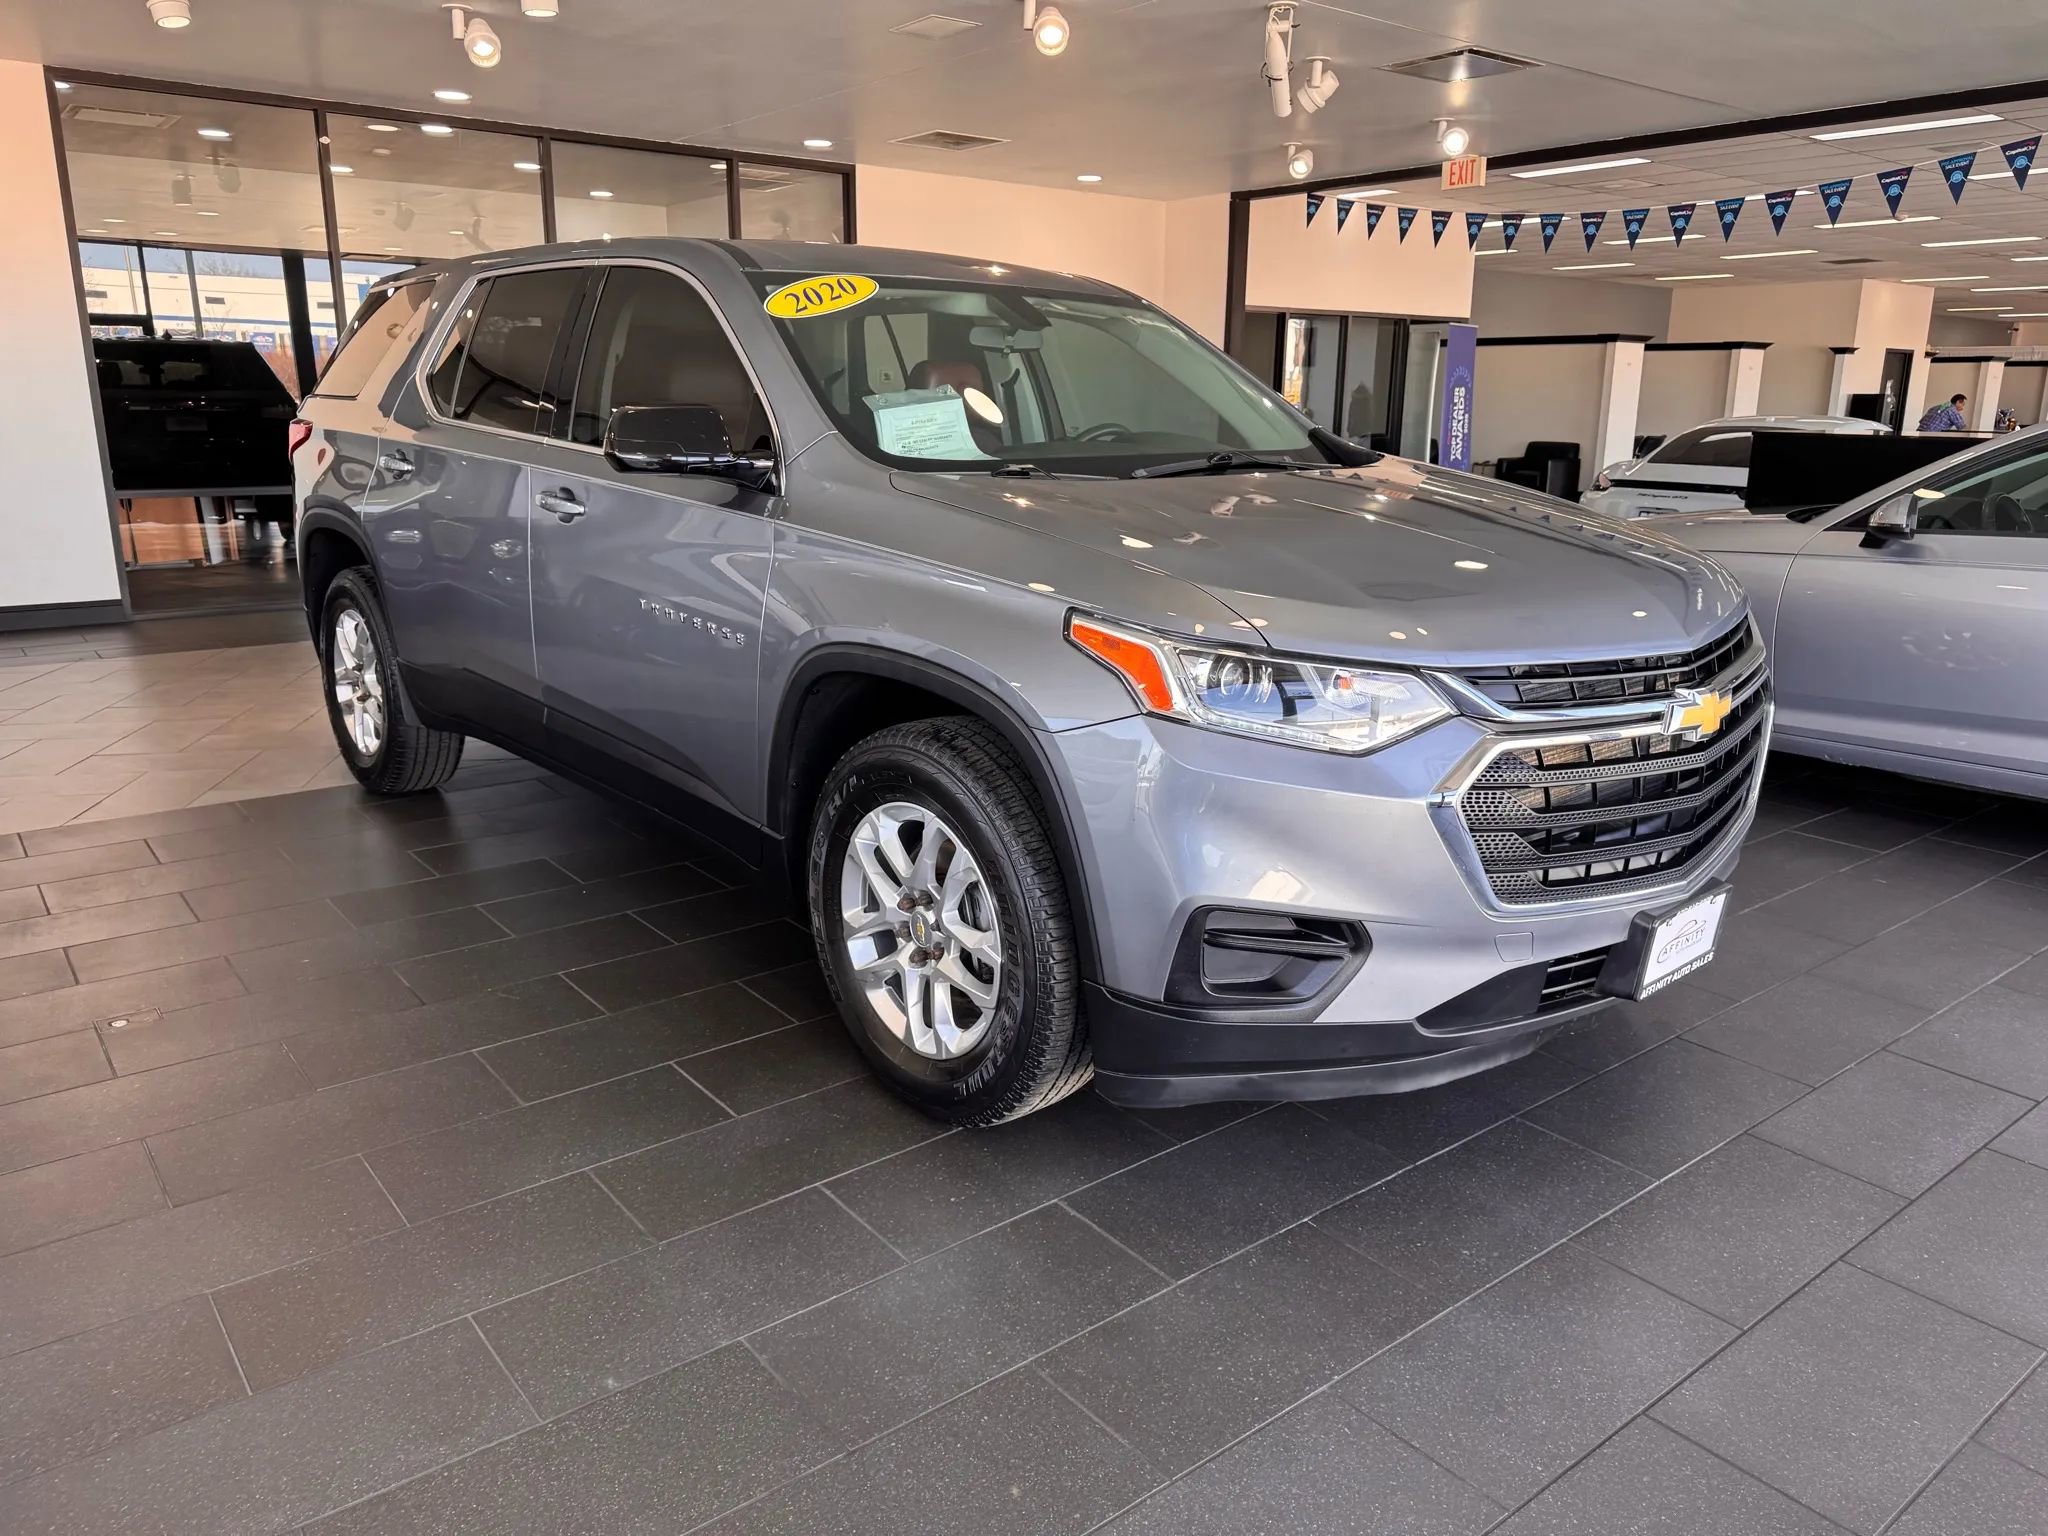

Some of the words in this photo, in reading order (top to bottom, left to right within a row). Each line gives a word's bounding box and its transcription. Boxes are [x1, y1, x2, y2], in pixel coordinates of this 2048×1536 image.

[1449, 159, 1476, 186] EXIT
[784, 277, 858, 314] 2020
[1451, 386, 1460, 436] DEALER
[1455, 386, 1466, 461] AWARDS
[639, 598, 745, 646] TRAVERSE
[1640, 974, 1673, 1000] AFFINITY
[1672, 964, 1692, 982] AUTO
[1691, 951, 1714, 971] SALES
